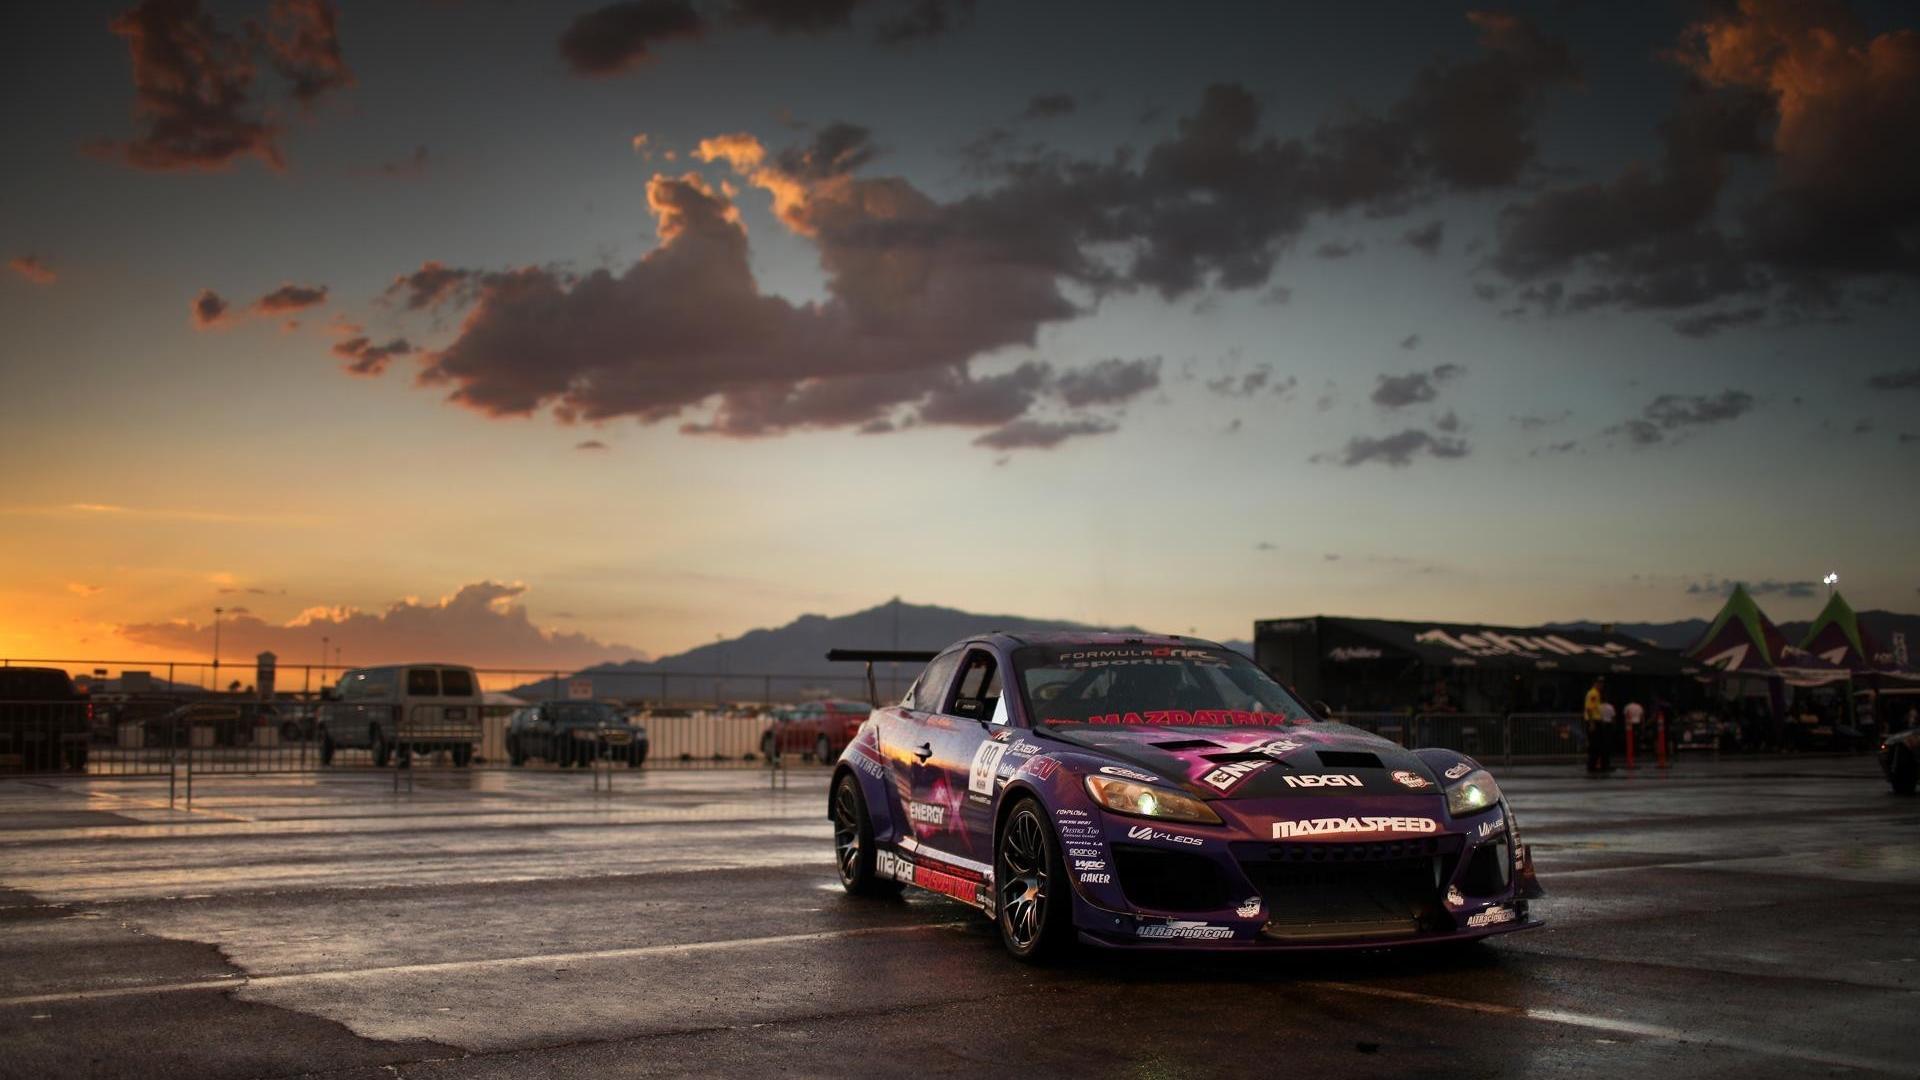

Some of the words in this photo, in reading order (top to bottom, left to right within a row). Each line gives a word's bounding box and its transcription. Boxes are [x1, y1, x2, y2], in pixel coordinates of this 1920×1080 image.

[1089, 709, 1286, 726] MAZDATRIX
[911, 801, 945, 825] ENERGY
[1272, 816, 1437, 839] MAZDASPEED
[1153, 832, 1204, 846] V-LEDS
[1069, 848, 1098, 856] sparco
[1080, 873, 1111, 884] BAKER
